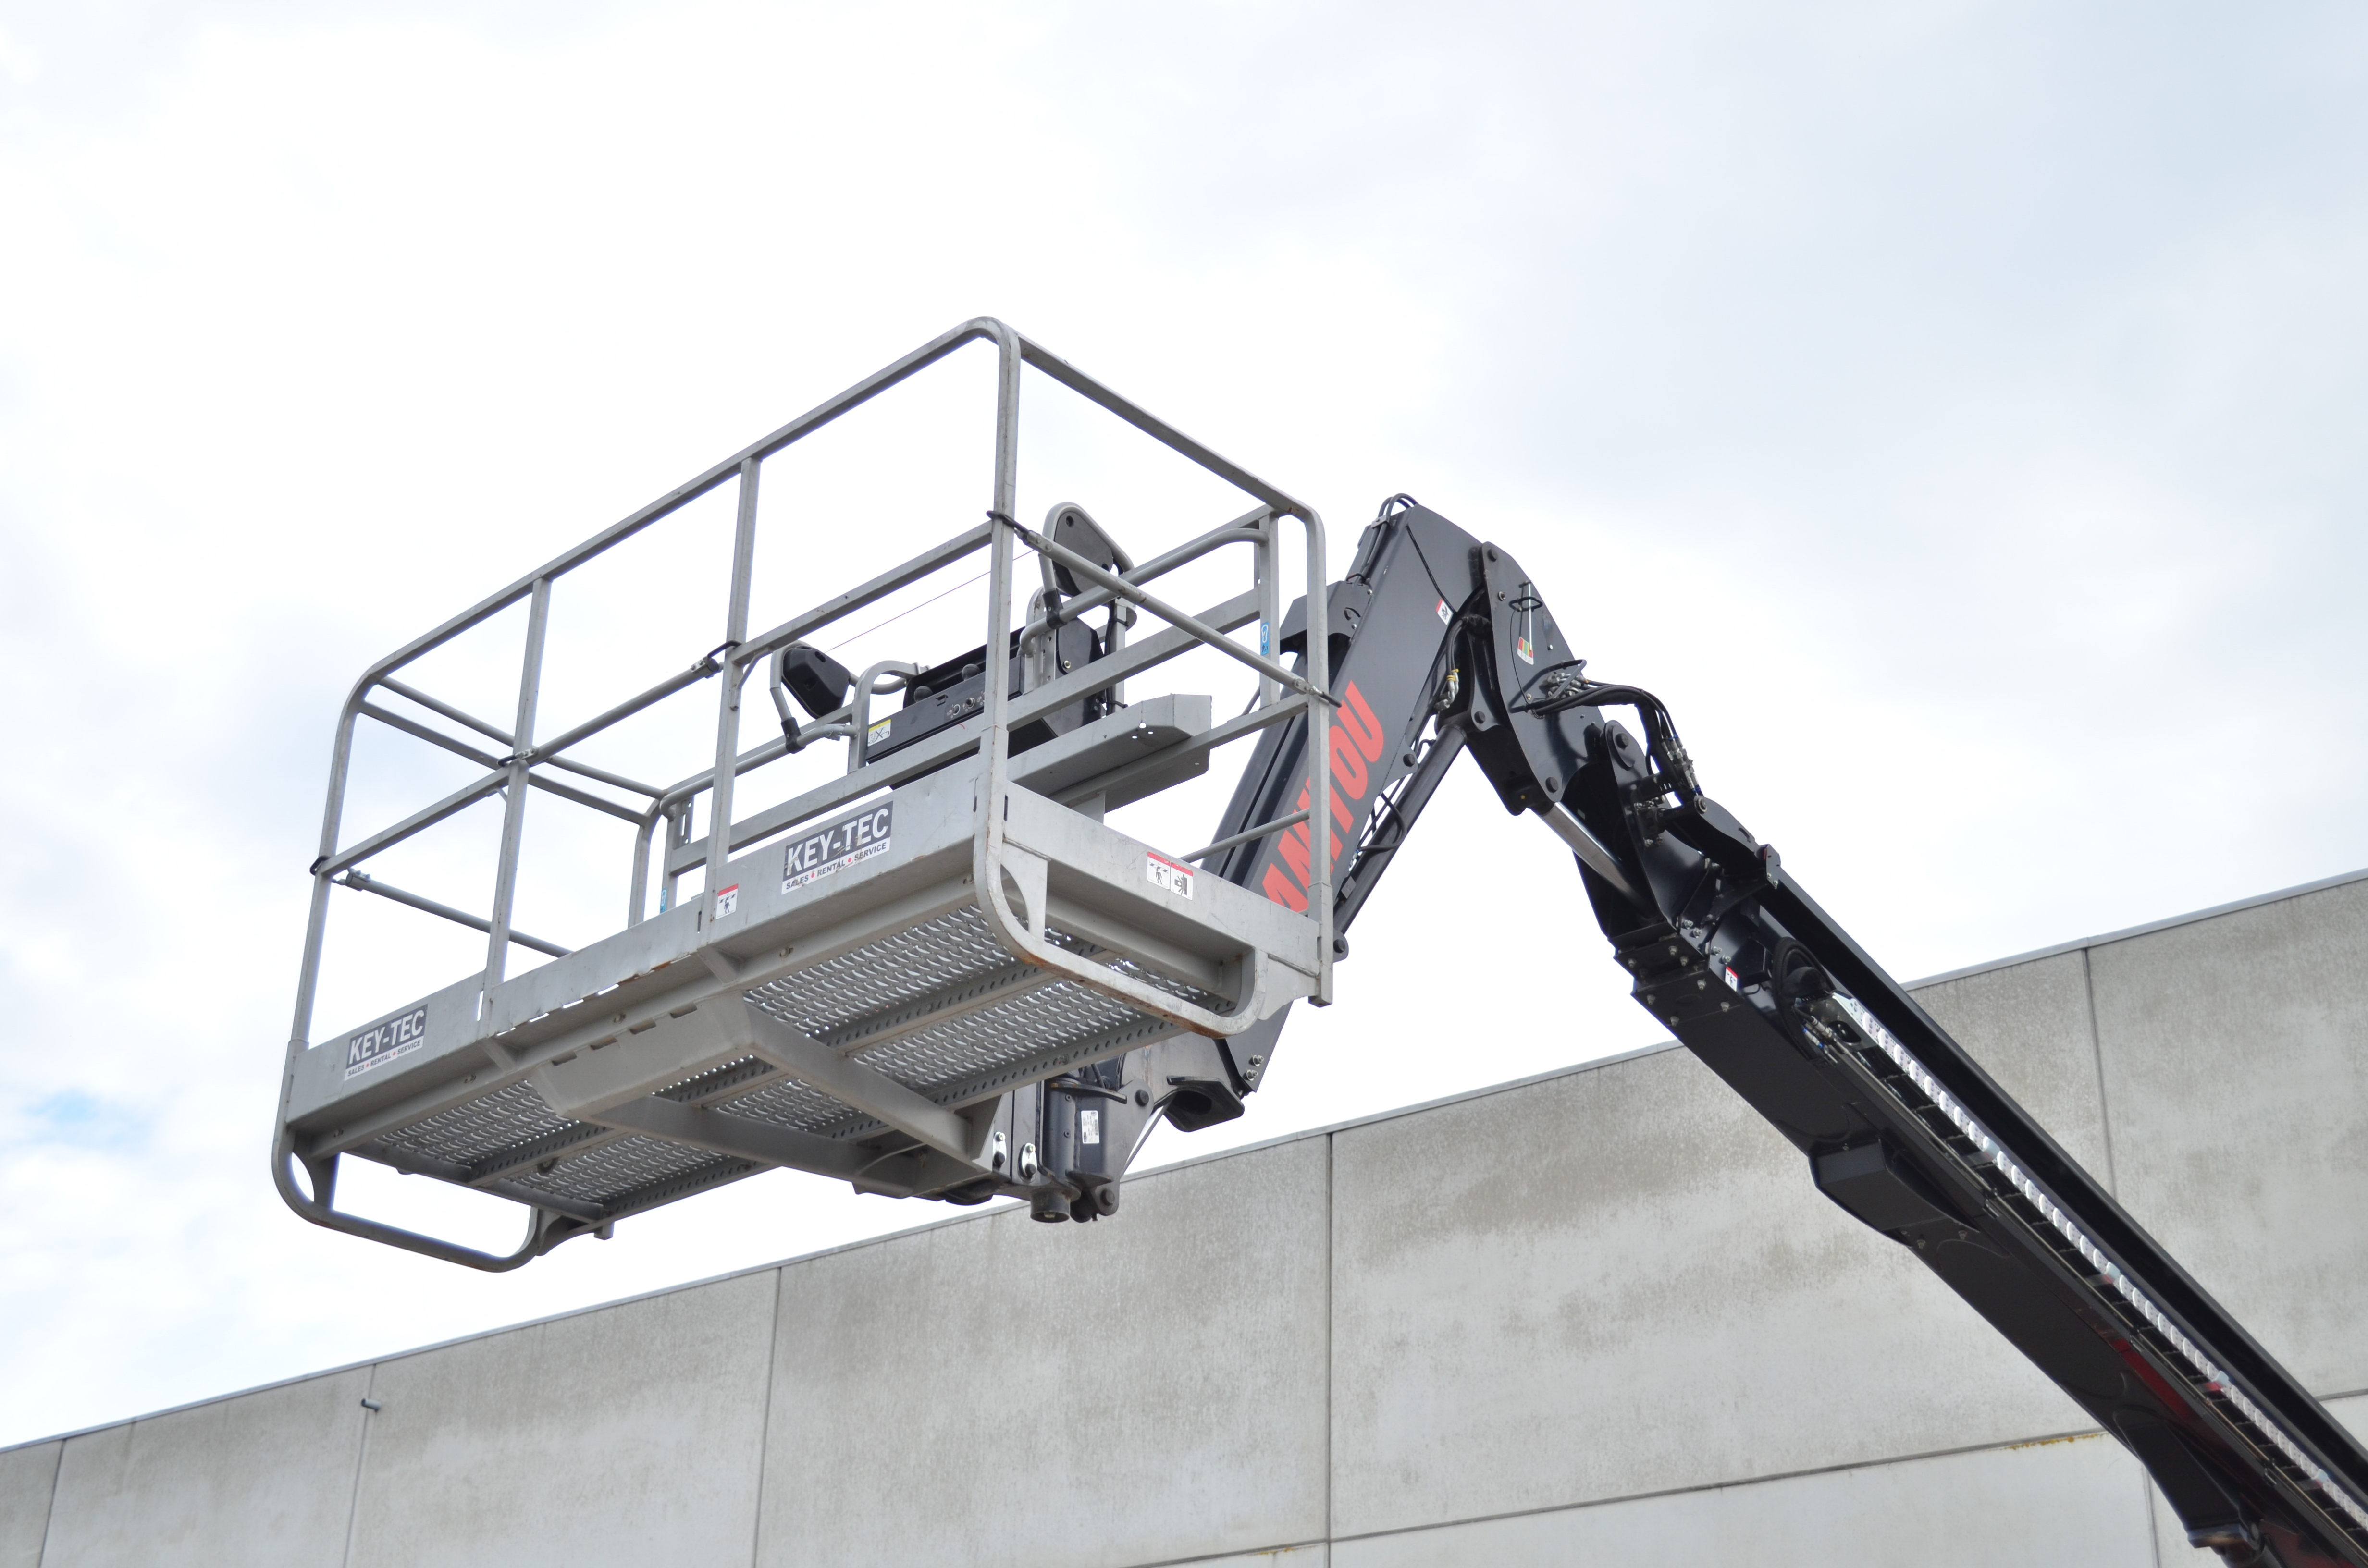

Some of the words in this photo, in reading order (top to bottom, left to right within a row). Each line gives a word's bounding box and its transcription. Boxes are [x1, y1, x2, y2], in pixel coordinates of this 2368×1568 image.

[786, 875, 809, 890] SALES
[817, 860, 846, 877] RENTAL
[854, 842, 887, 861] SERVICE
[787, 808, 889, 876] KEY-TEC
[347, 1065, 365, 1077] SALES
[370, 1053, 391, 1067] RENTAL
[397, 1040, 421, 1055] SERVICE
[349, 1009, 424, 1065] KEY-TEC
